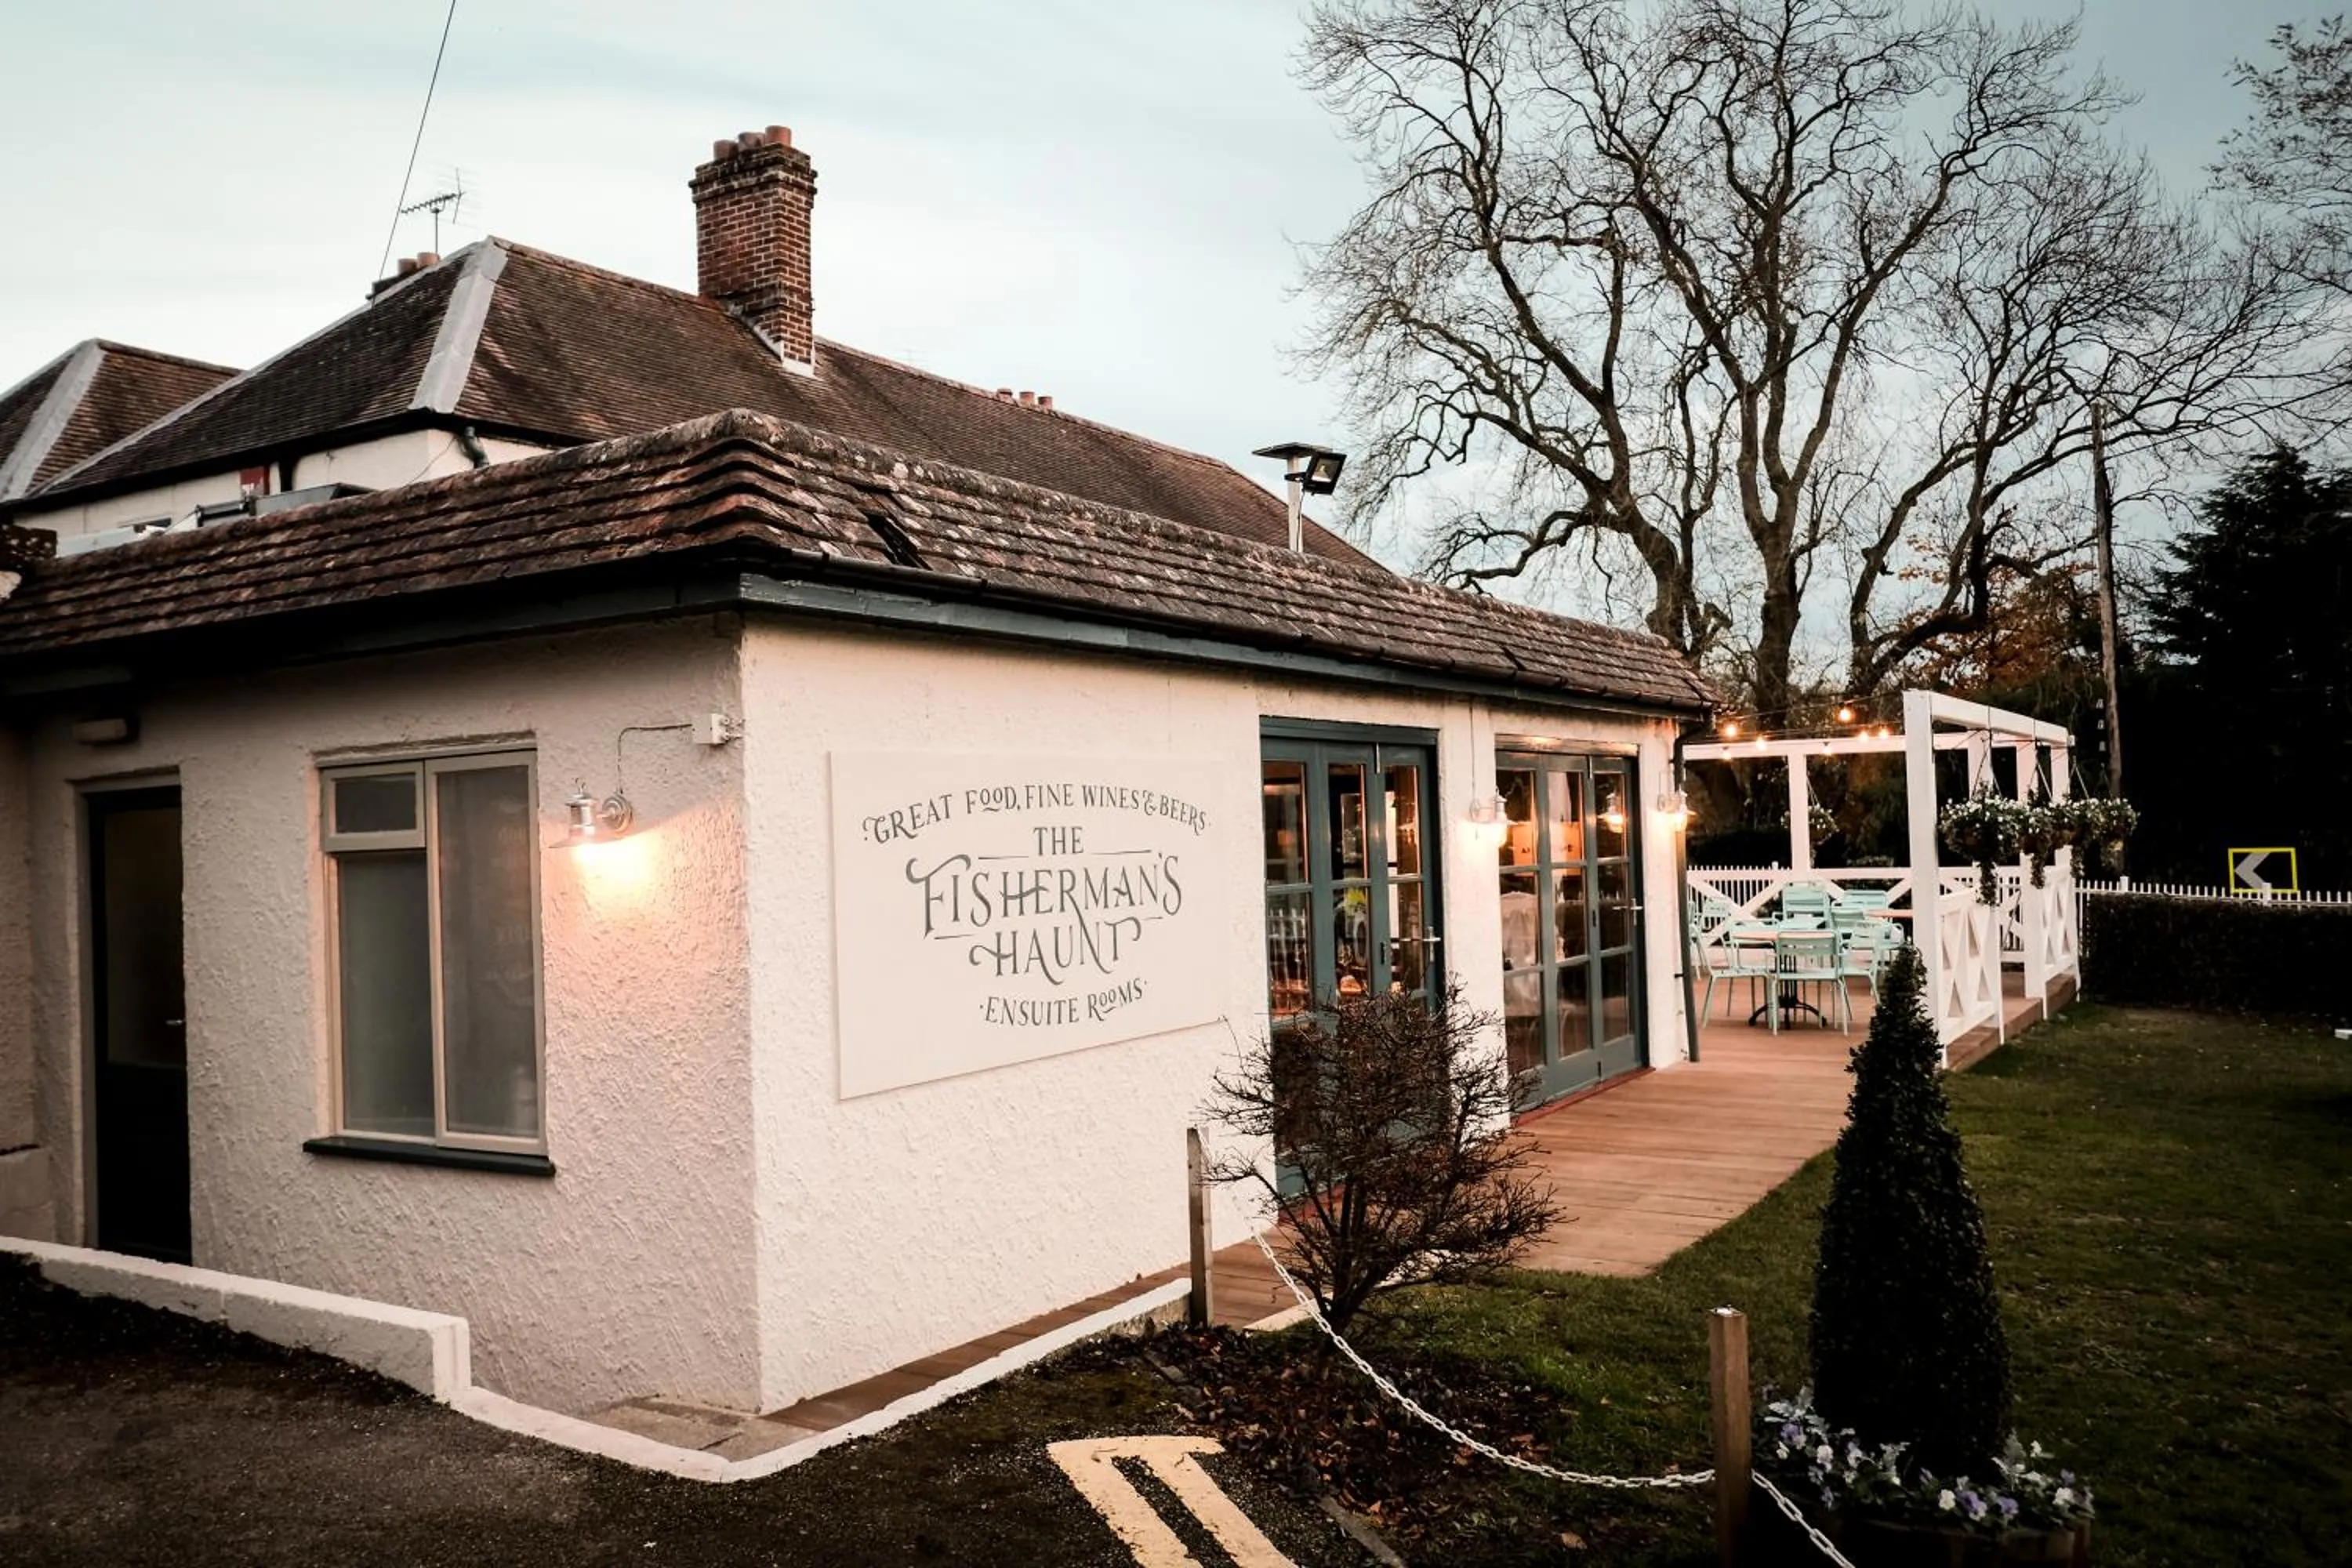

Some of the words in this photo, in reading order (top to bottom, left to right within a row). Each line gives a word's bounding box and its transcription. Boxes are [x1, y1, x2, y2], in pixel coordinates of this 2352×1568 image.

[862, 793, 953, 844] GREAT
[1024, 784, 1075, 809] FINE
[1081, 785, 1140, 811] WINES
[1160, 794, 1207, 837] BEERS
[1033, 826, 1085, 857] THE
[906, 851, 1182, 939] FISHERMAN'S
[968, 916, 1142, 986] HAUNT
[985, 996, 1080, 1026] ENSUITE
[1087, 977, 1143, 1022] ROOMS
